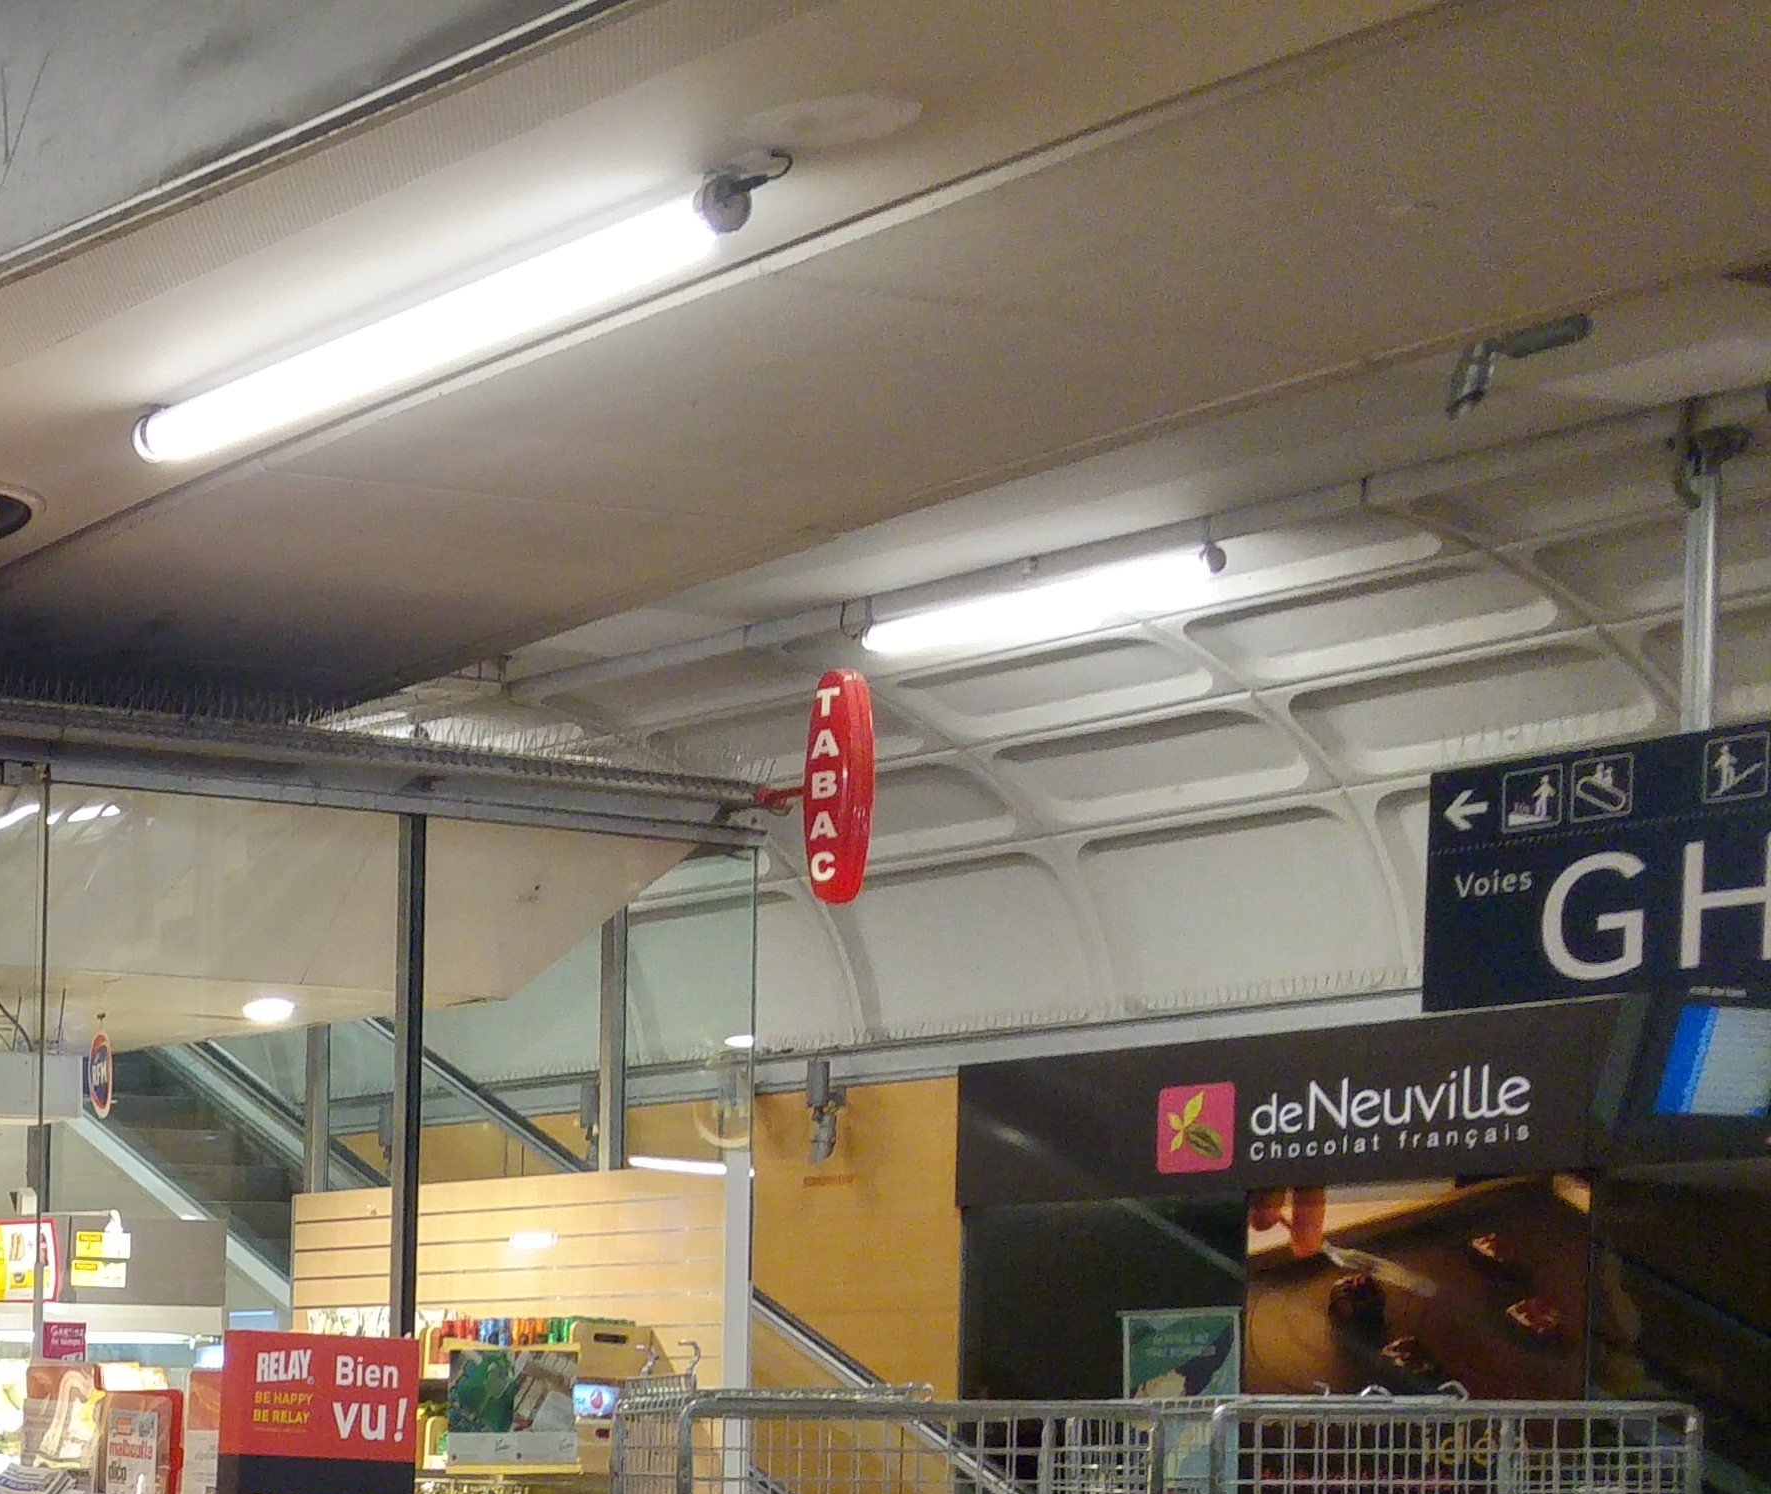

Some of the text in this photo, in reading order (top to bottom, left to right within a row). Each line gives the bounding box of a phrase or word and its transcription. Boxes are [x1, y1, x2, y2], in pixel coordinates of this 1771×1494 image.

[810, 687, 840, 882] TABAC
[1454, 832, 1771, 980] Voies G H
[1250, 1122, 1530, 1162] Chocolat français
[335, 1355, 398, 1389] Bien
[253, 1408, 311, 1424] BE RELAY
[255, 1391, 313, 1405] BE HAPPY
